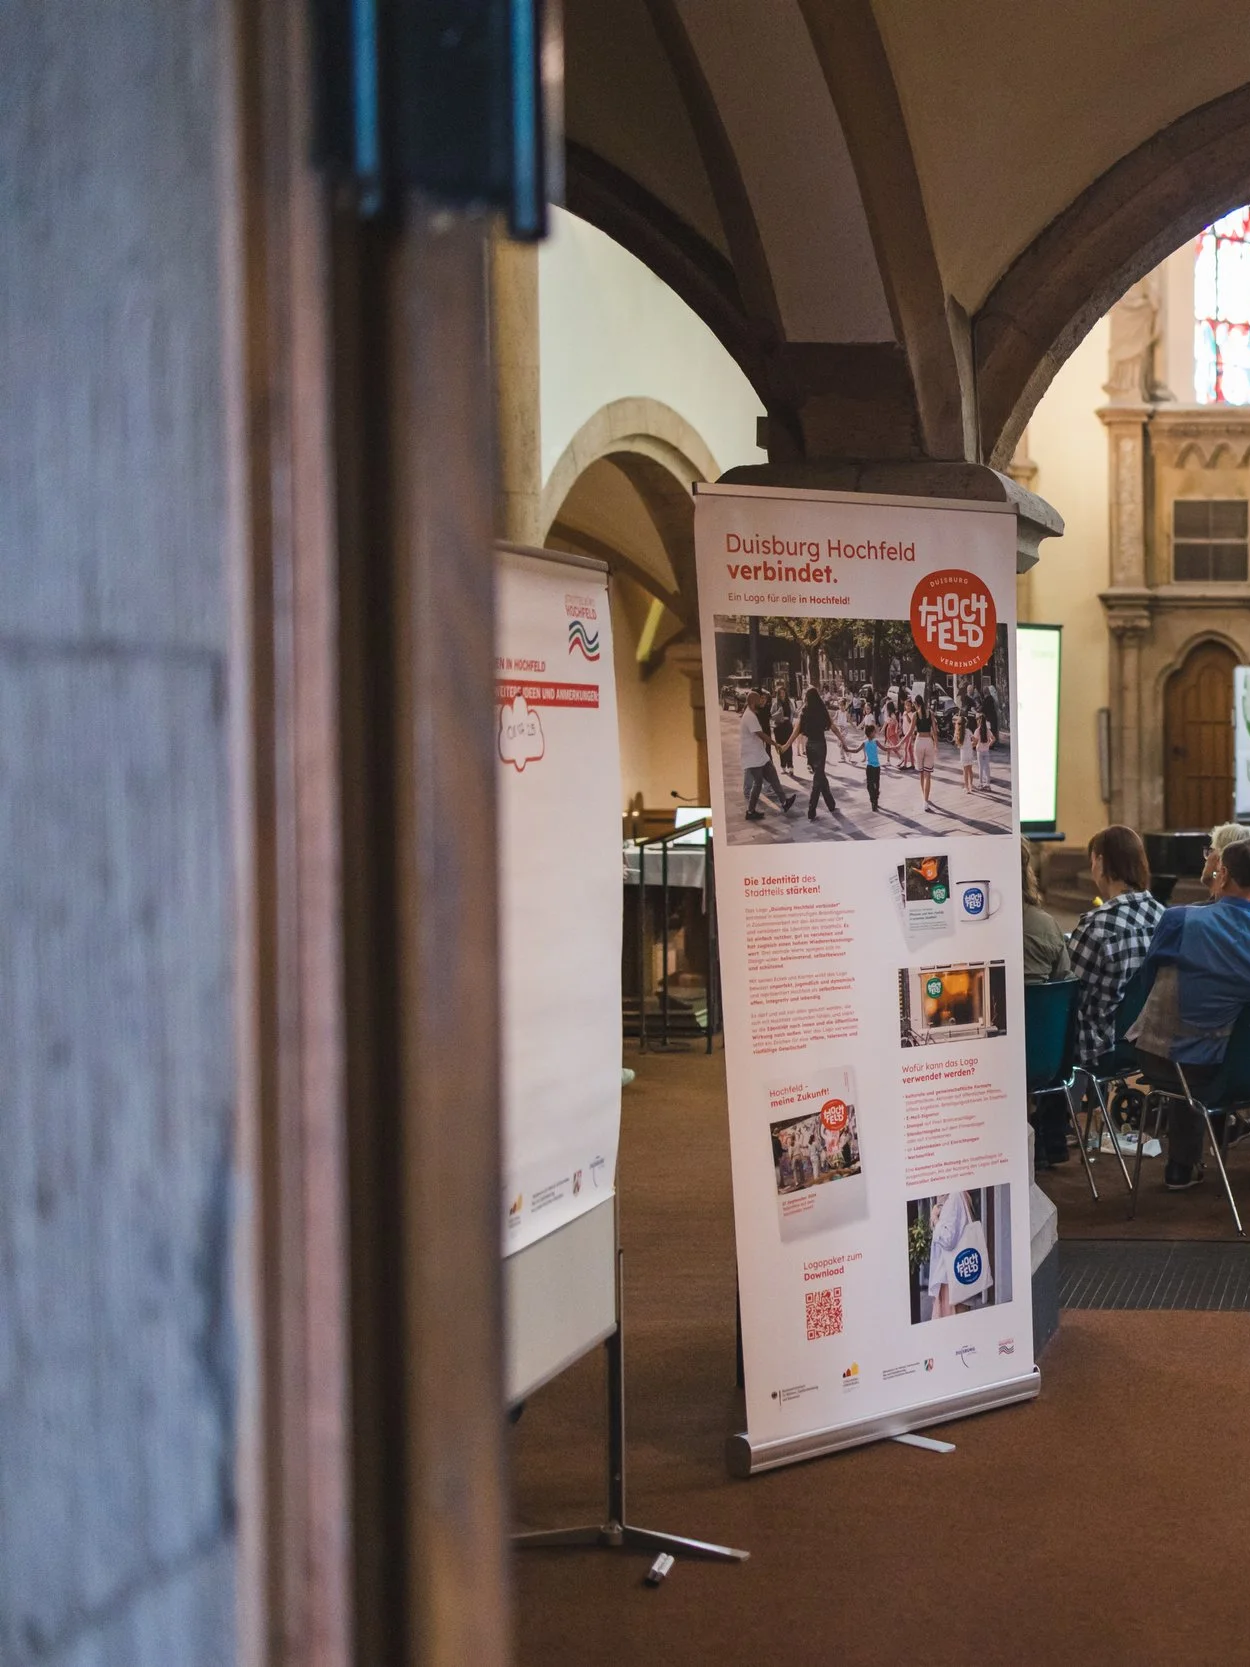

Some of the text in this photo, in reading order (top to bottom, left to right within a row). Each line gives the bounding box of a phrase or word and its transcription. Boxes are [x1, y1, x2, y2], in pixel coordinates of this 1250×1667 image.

[726, 534, 915, 562] Duisburg Hochfeld
[727, 560, 838, 583] verbindet.
[930, 577, 968, 587] DUISBURG
[728, 593, 741, 601] Ein
[744, 594, 765, 604] Logo
[768, 594, 779, 602] für
[782, 595, 796, 603] alle
[810, 596, 850, 605] Hochfeld!
[566, 605, 596, 619] HOCHFELD
[919, 593, 988, 627] HOCH
[927, 615, 983, 650] FELD
[506, 660, 512, 670] IN
[515, 660, 545, 672] HOCHFELD
[940, 656, 981, 667] VERBINDET
[542, 689, 555, 699] UND
[744, 877, 758, 885] Die
[762, 875, 799, 885] Identität
[745, 885, 820, 897] Stadtteils stärken!
[902, 1058, 978, 1073] Wofür kann das Logo
[903, 1067, 975, 1084] verwendet werden?
[770, 1084, 803, 1097] Hochfeld
[771, 1088, 830, 1108] meine Zukunft!
[824, 1104, 844, 1119] HOCH
[804, 1253, 862, 1270] Logopaket zum
[804, 1266, 844, 1281] Download
